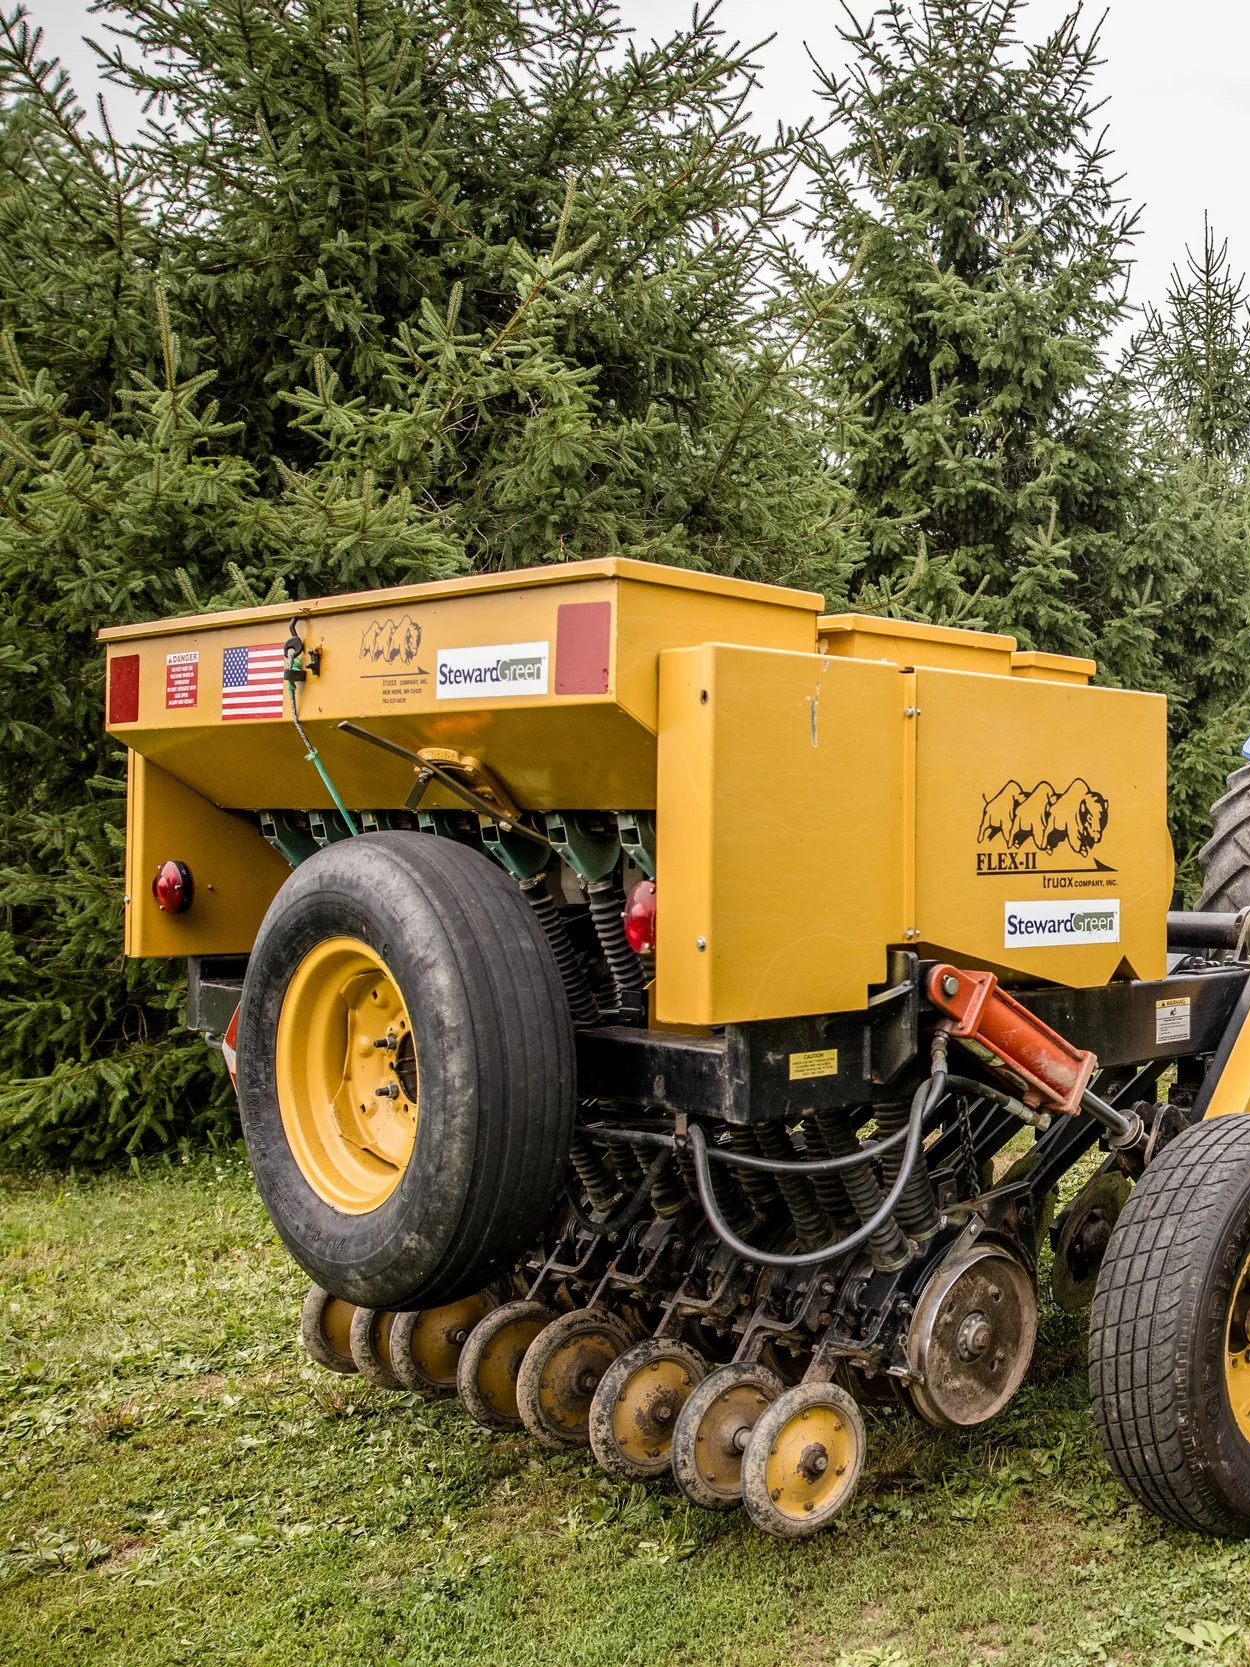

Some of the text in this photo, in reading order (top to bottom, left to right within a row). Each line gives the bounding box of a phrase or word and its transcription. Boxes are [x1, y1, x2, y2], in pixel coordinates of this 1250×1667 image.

[173, 653, 197, 663] DANGER
[976, 852, 1037, 870] FLEX-II
[1043, 876, 1074, 888] truax
[1074, 880, 1105, 888] COMPANY,
